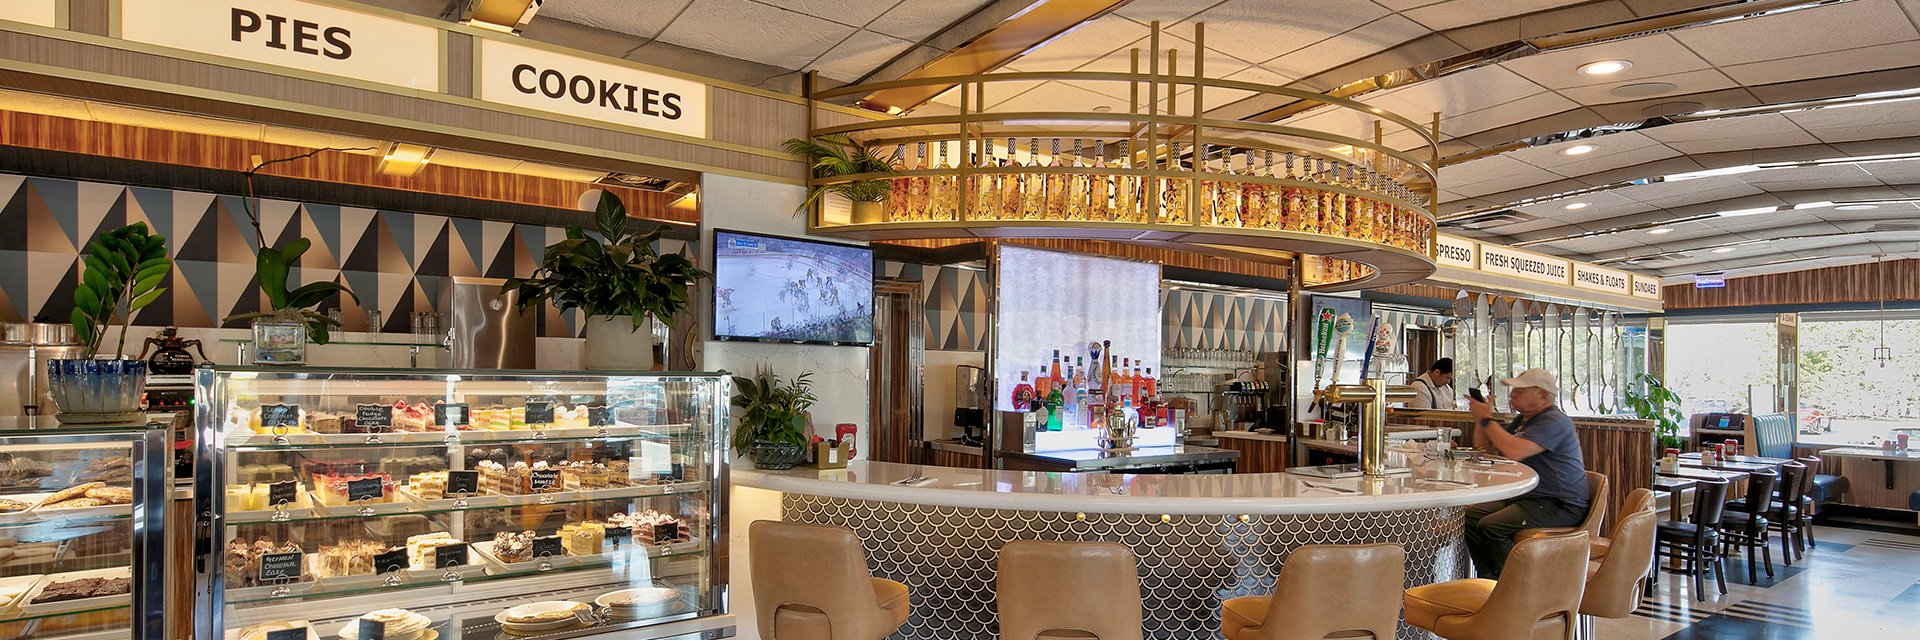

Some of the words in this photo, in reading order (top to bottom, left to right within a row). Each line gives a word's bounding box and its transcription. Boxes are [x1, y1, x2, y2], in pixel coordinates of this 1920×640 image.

[231, 7, 352, 60] PIES
[512, 64, 682, 120] COOKIES
[1485, 252, 1509, 268] FRESH
[1511, 257, 1545, 274] SQUEEZED
[1546, 264, 1565, 278] JUICE
[1577, 270, 1599, 284] SHAKES
[1600, 274, 1605, 286] &
[1606, 275, 1625, 289] FLOATS
[1635, 281, 1656, 295] SUNDAES
[1319, 322, 1329, 354] Heineken
